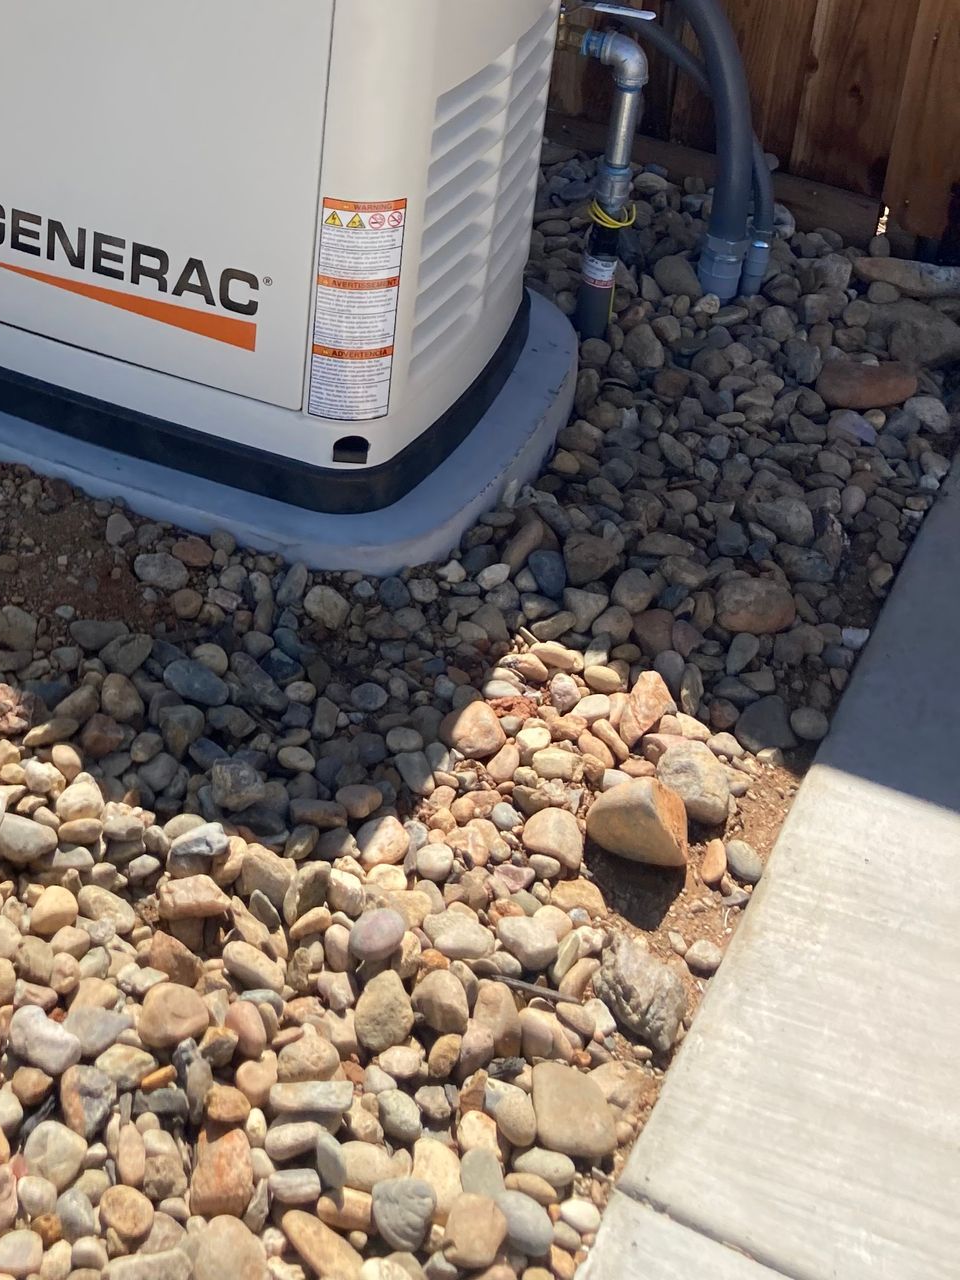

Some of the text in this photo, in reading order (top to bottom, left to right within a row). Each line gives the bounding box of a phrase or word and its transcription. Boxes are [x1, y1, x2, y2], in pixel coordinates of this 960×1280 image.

[354, 203, 393, 212] WARNING
[332, 278, 397, 289] AVERTISSEMENT
[332, 349, 388, 359] ADVERTENCIA
